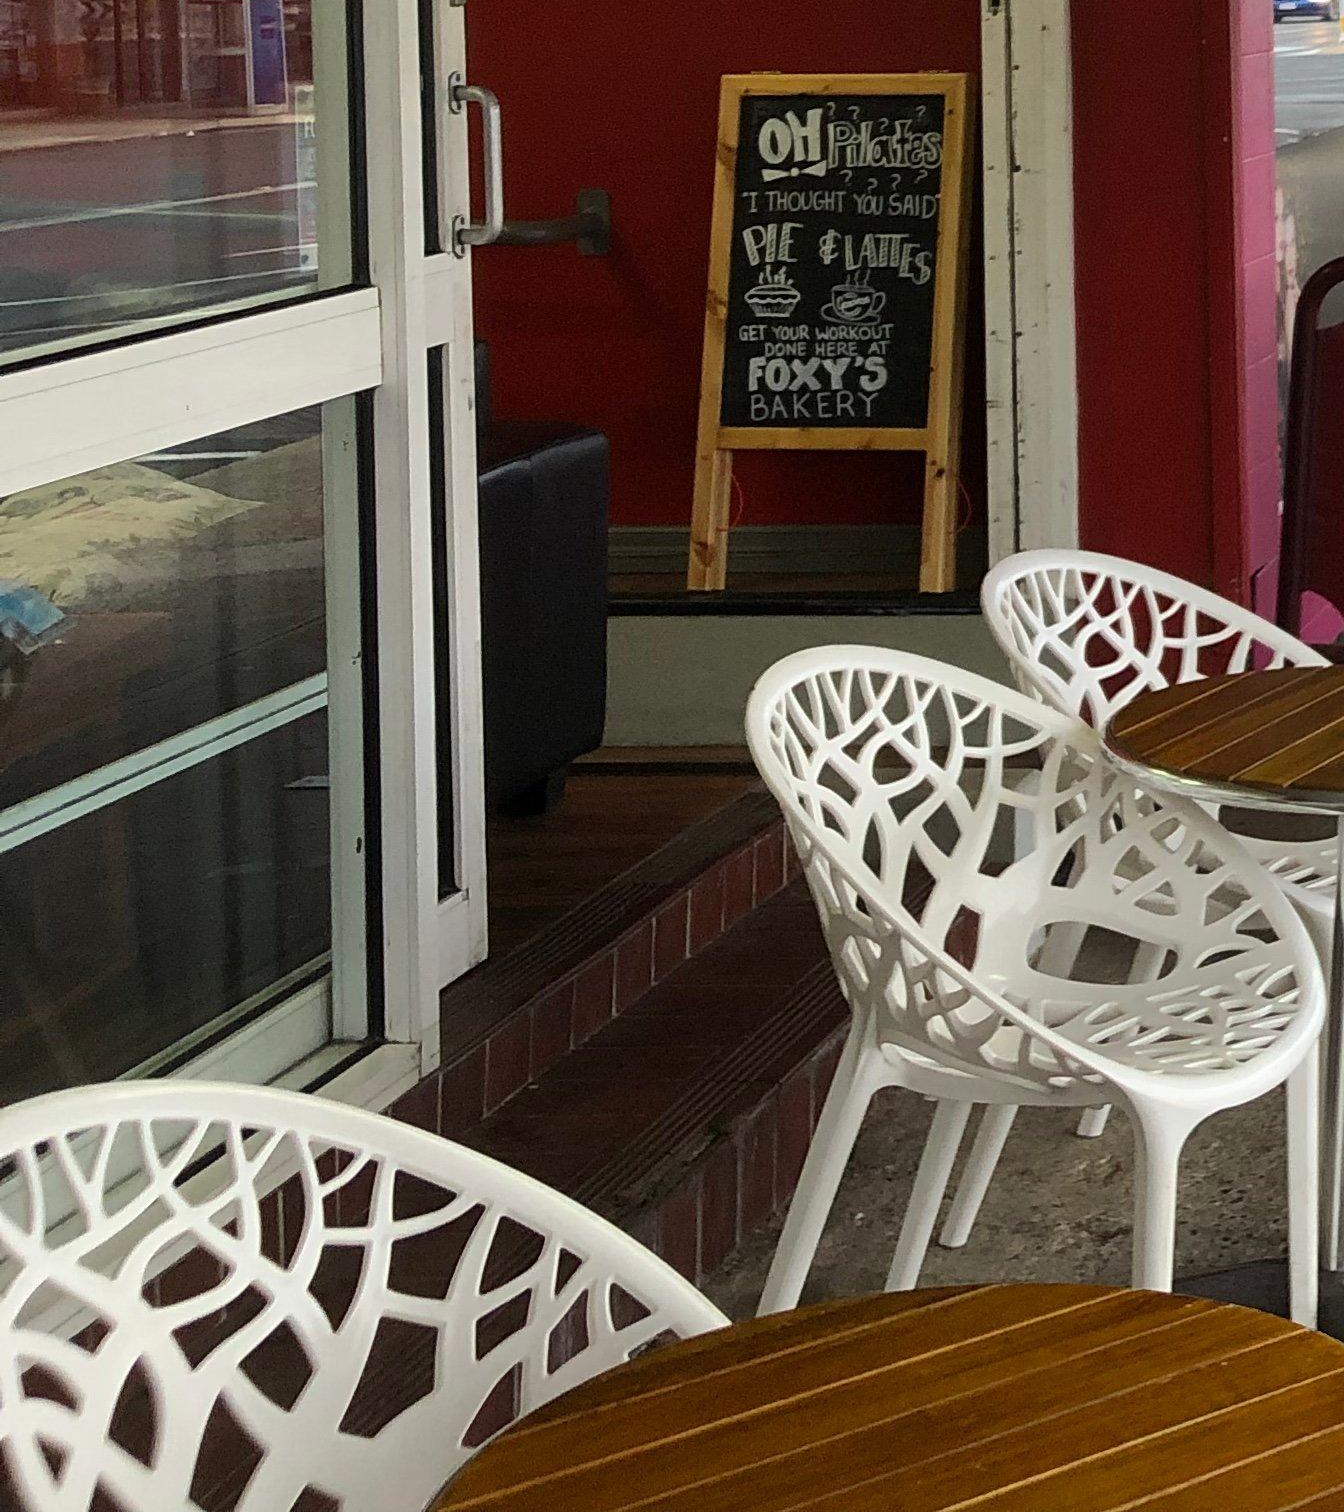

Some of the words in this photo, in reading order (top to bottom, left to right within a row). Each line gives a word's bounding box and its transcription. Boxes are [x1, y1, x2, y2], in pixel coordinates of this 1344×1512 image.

[758, 108, 823, 164] OH
[828, 119, 943, 169] Pilates
[765, 190, 847, 213] THOUGHT
[853, 193, 884, 216] YOU
[742, 222, 804, 266] PIE
[844, 233, 933, 285] LATTES
[738, 324, 767, 341] GET
[773, 324, 810, 341] YOUR
[815, 323, 895, 340] WORKOUT
[764, 342, 807, 357] DONE
[815, 341, 859, 357] HERE
[867, 340, 891, 355] AT
[748, 356, 888, 392] FOXY'S
[750, 390, 879, 421] BAKERY
